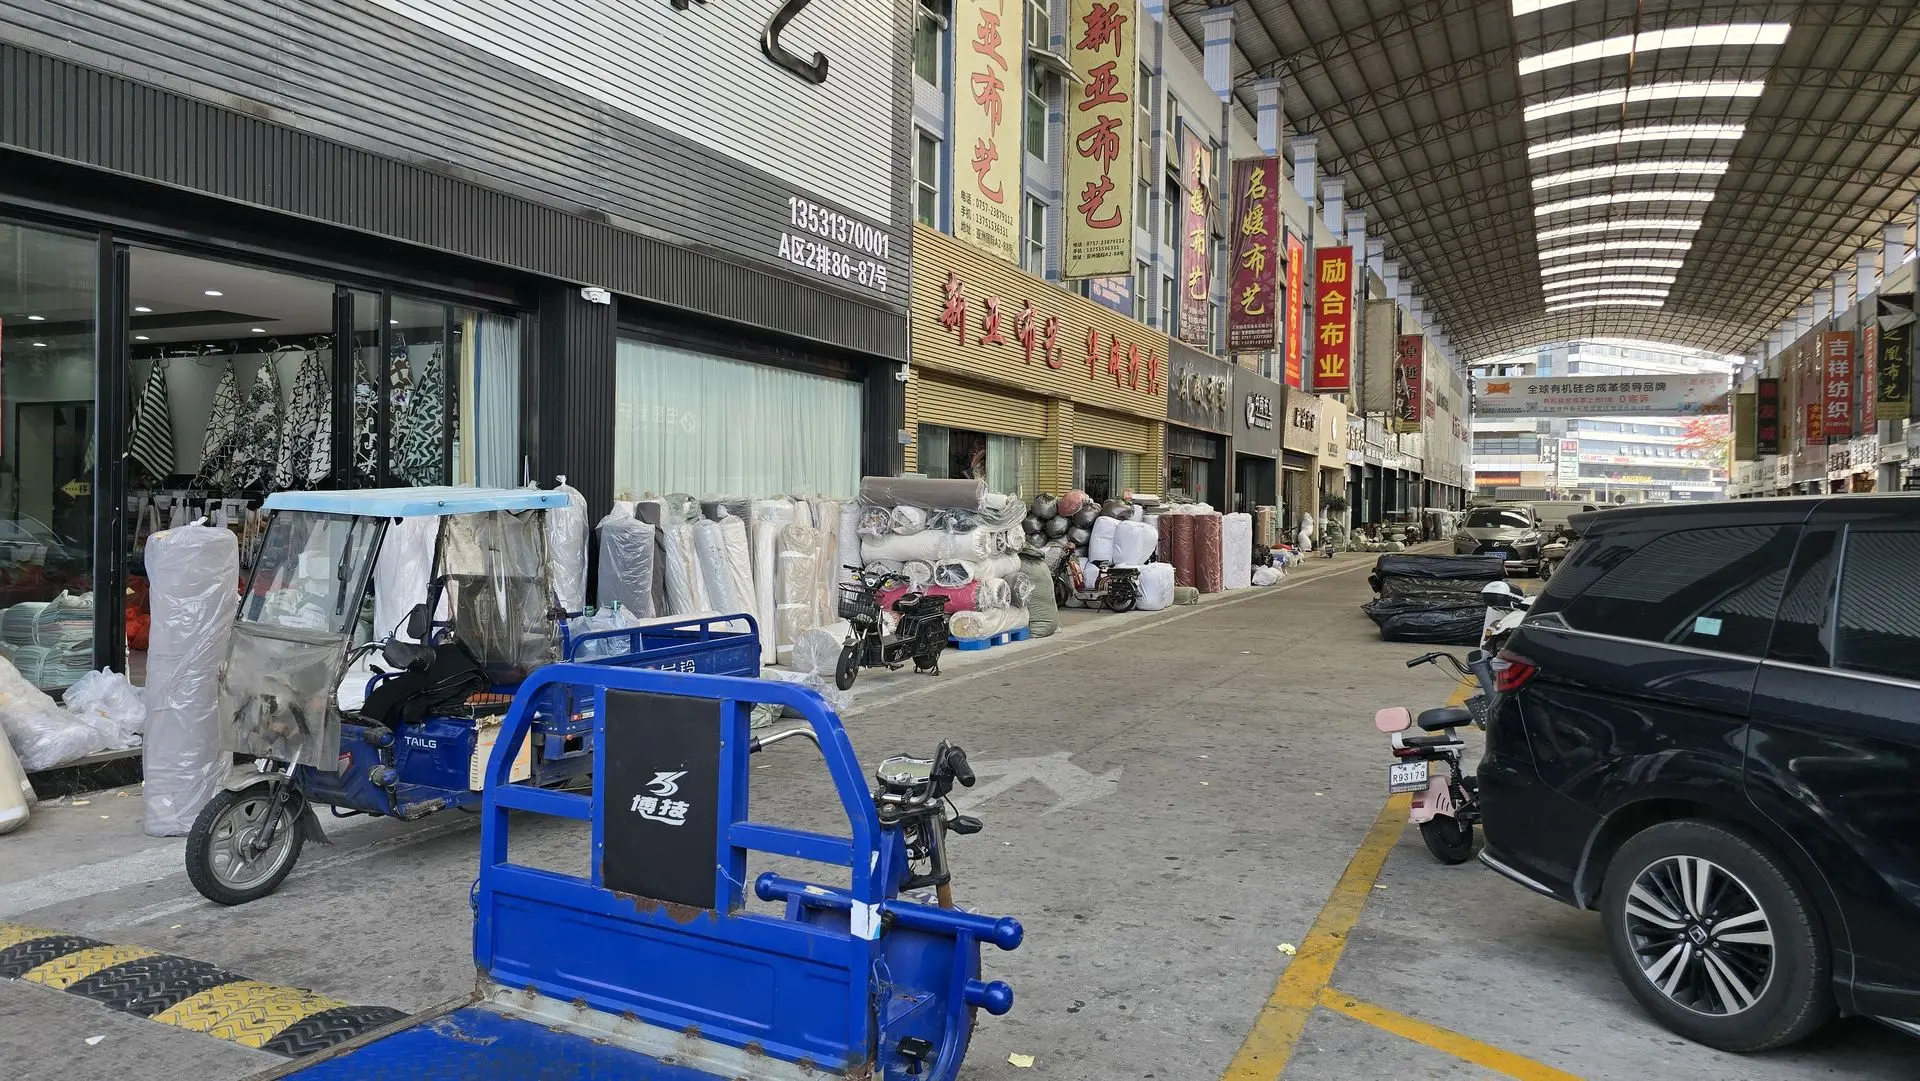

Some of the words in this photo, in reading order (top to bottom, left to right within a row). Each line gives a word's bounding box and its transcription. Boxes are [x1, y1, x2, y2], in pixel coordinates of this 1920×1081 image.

[971, 0, 1008, 204] 亚布艺
[1076, 3, 1128, 229] 新亚布艺
[788, 197, 889, 259] 13531370001
[1240, 167, 1268, 316] 名媛布艺
[778, 233, 888, 292] A区2排86-87号
[1319, 258, 1346, 377] 励合布业
[1528, 382, 1667, 395] 全球有机硅合成革领导品牌
[1827, 339, 1849, 418] 吉祥纺织
[404, 736, 437, 749] TAILG
[1393, 770, 1425, 783] R93179
[631, 794, 689, 825] 博技
